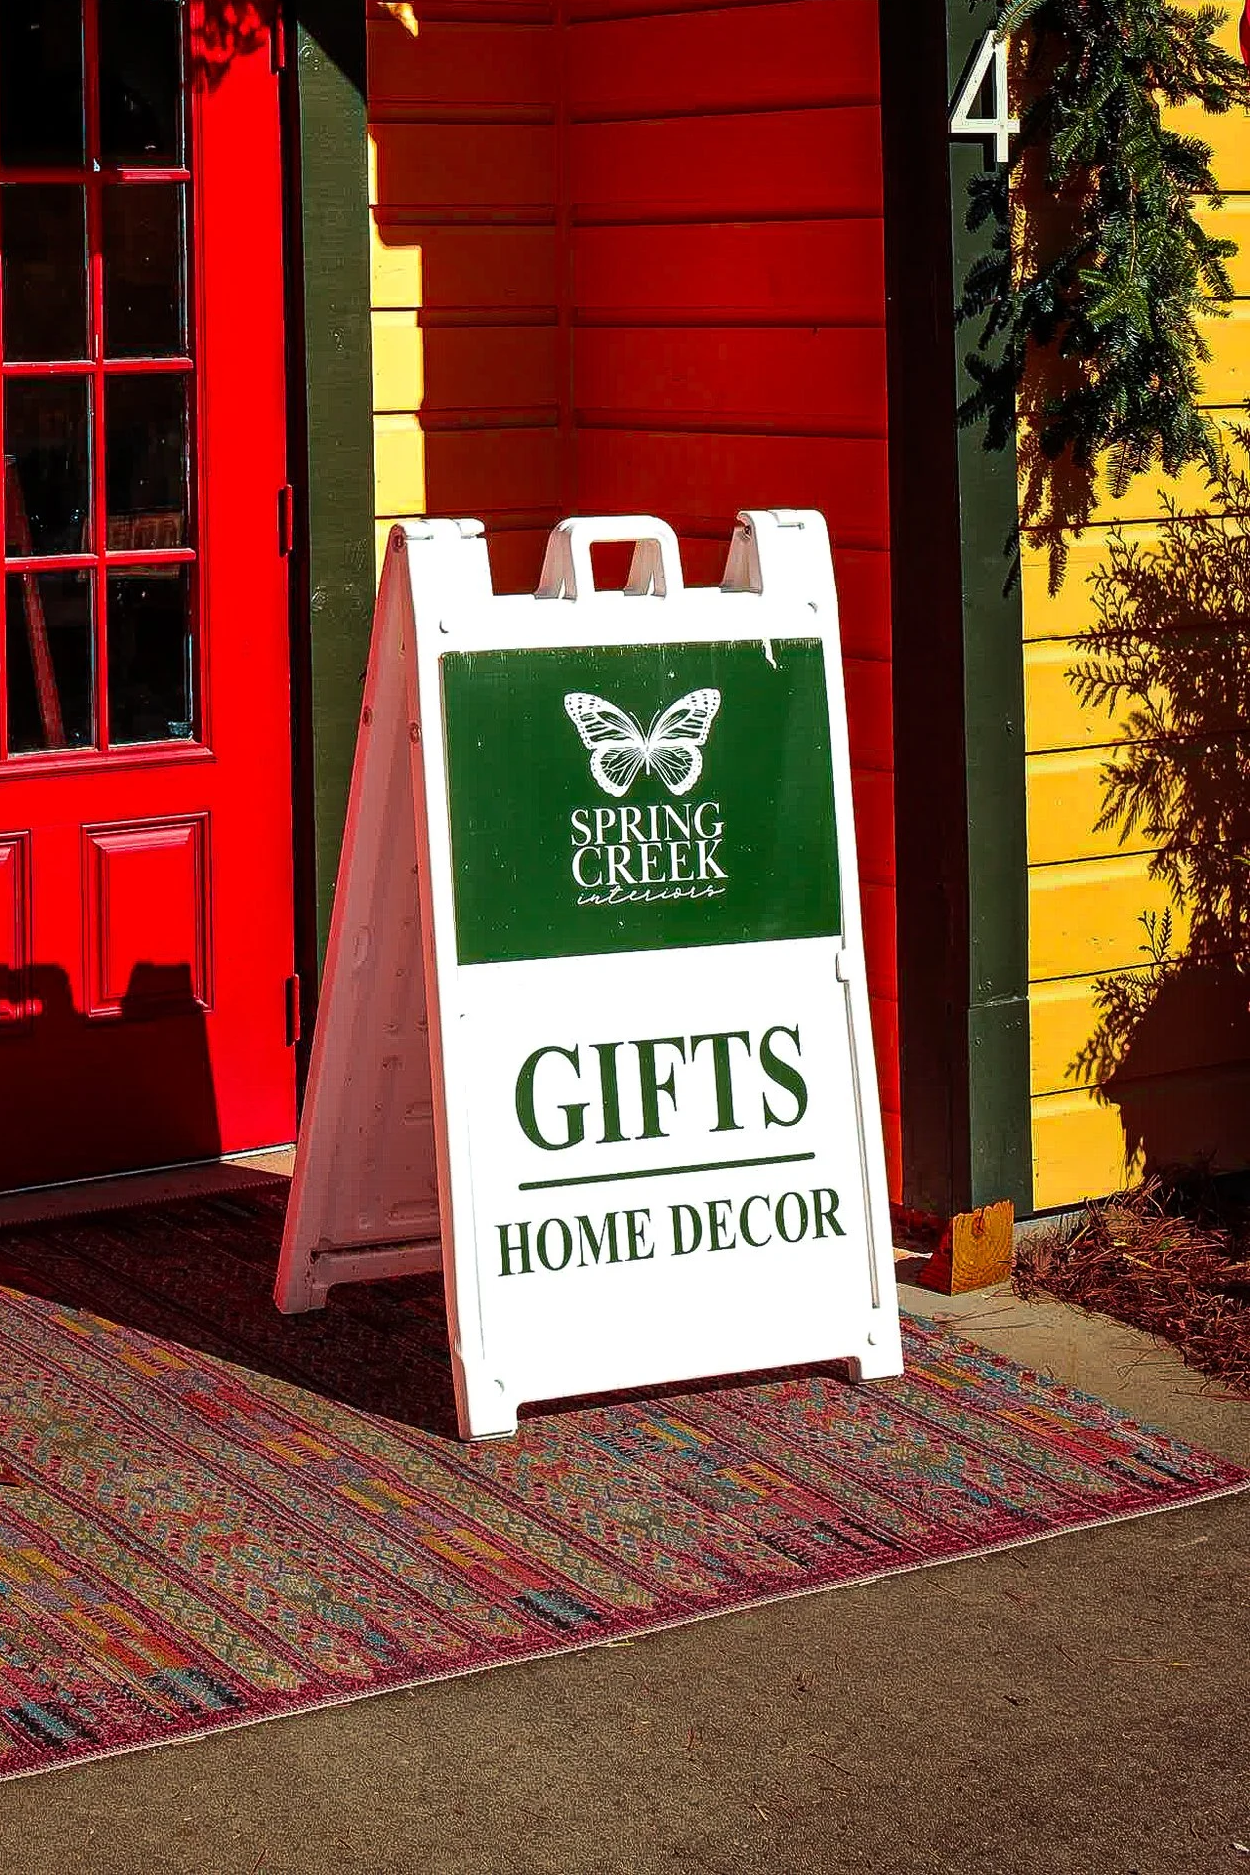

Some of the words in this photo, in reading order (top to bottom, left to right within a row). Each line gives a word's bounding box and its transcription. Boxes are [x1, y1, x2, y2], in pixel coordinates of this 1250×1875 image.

[571, 802, 725, 846] SPRING
[572, 839, 729, 888] CREEK
[577, 884, 726, 905] interiors
[515, 1024, 808, 1151] GIFTS
[495, 1208, 655, 1276] HOME
[667, 1188, 847, 1255] DECOR
